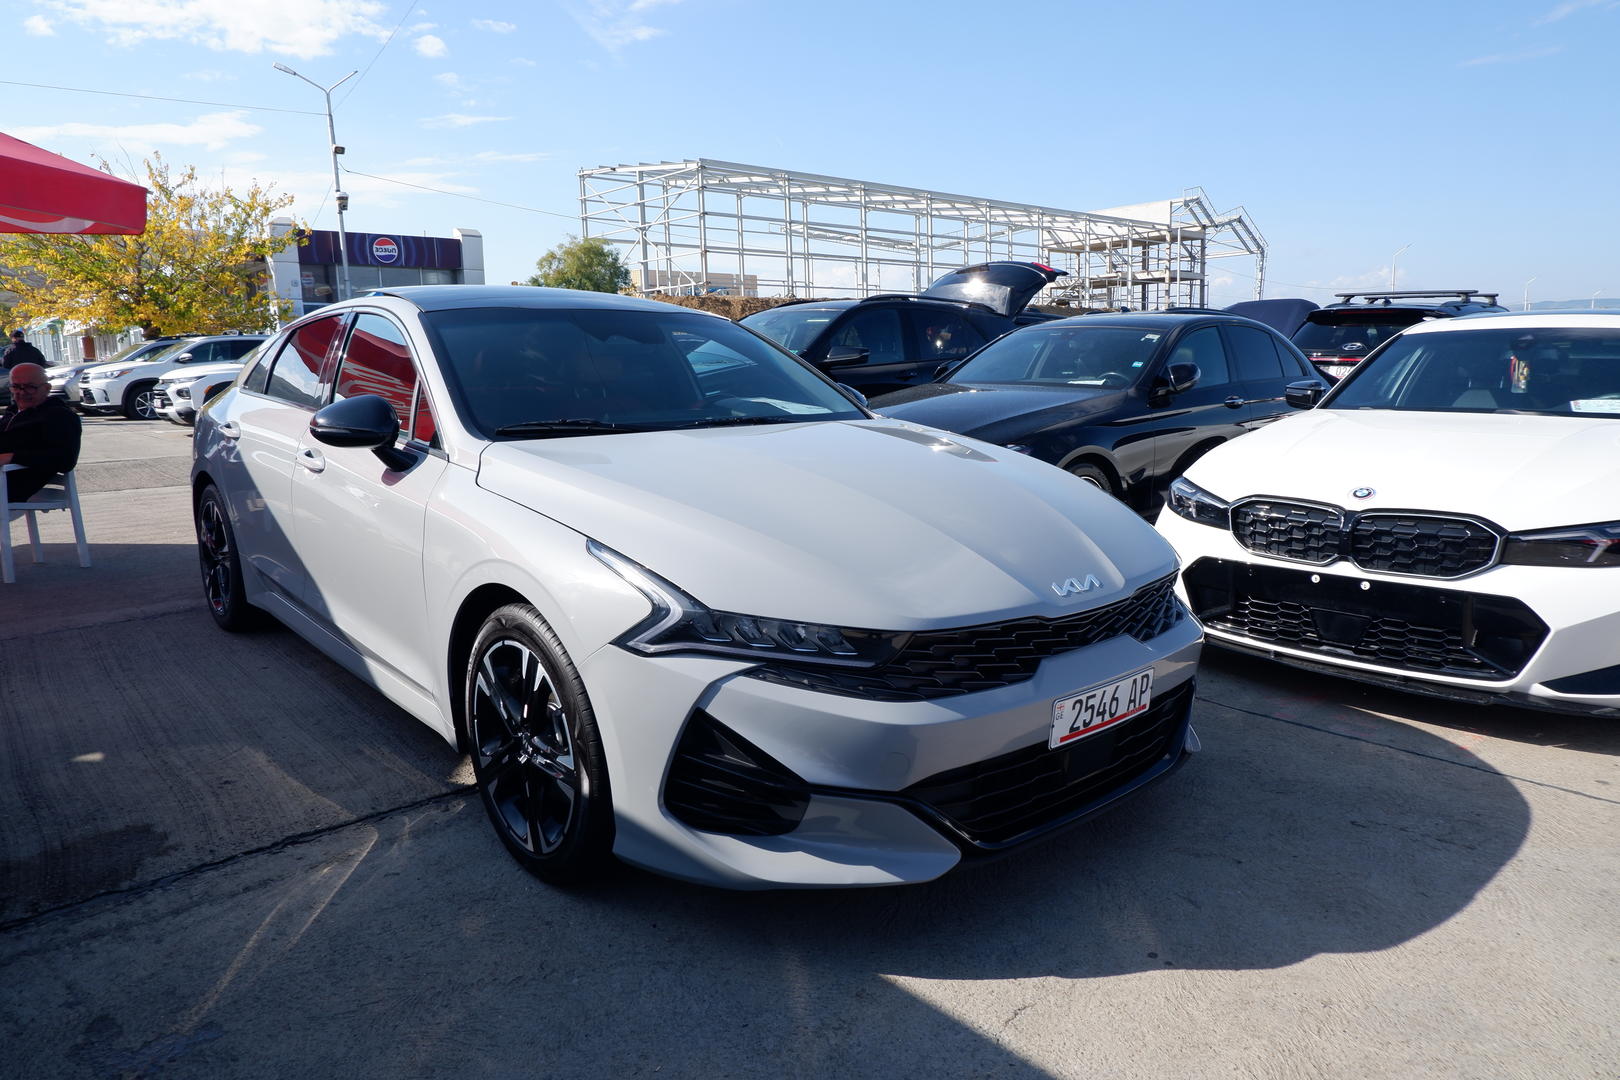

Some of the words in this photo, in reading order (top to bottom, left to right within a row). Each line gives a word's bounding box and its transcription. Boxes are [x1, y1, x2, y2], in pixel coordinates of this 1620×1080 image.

[1051, 574, 1100, 597] KIA
[1068, 685, 1120, 734] 2546
[1127, 673, 1150, 712] AP
